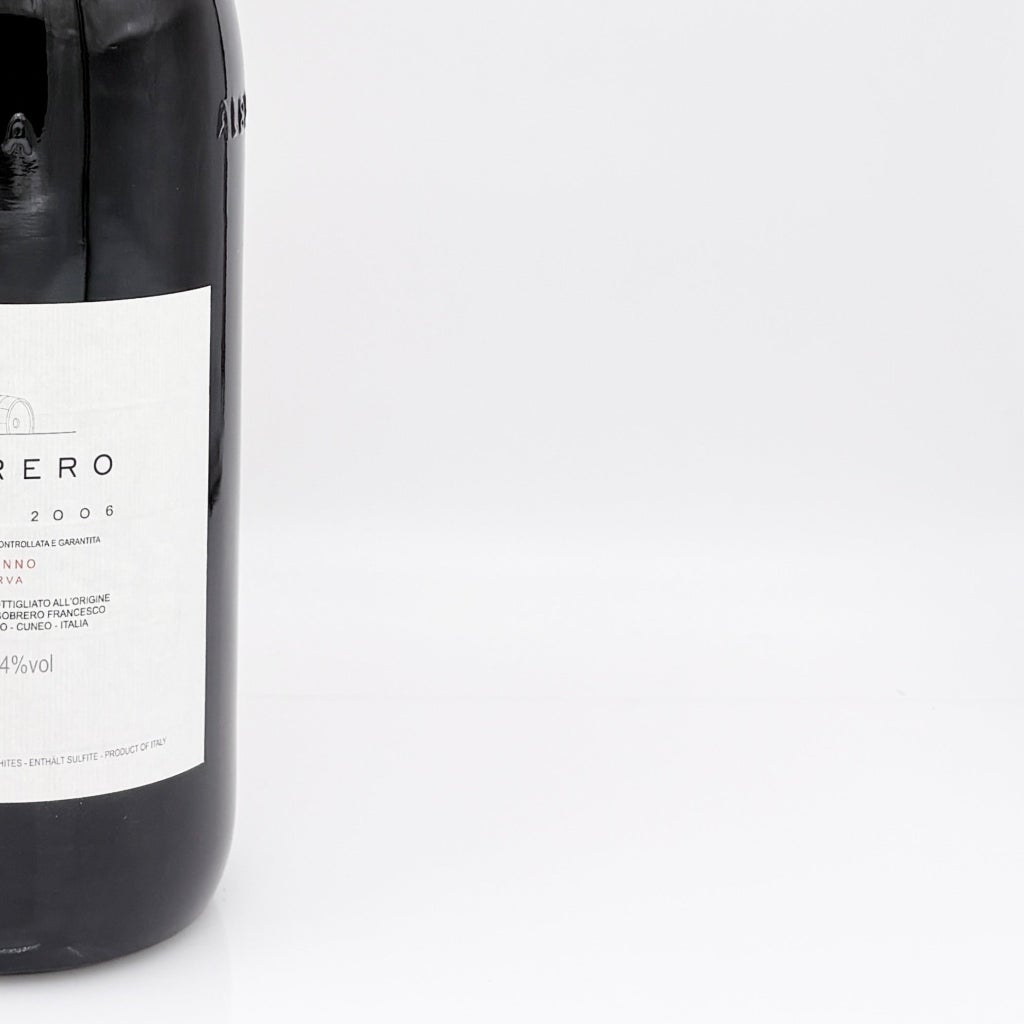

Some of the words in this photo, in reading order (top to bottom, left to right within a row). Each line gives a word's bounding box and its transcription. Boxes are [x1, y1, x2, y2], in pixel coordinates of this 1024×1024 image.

[30, 505, 114, 522] 2006
[51, 538, 57, 547] E
[58, 535, 101, 547] GARANTITA
[52, 593, 111, 607] ALL'ORIGINE
[47, 605, 106, 618] FRANCESCO
[16, 621, 52, 632] CUNEO
[60, 619, 89, 630] ITALIA
[67, 752, 98, 764] SULFITE
[104, 744, 141, 758] PRODUCT
[140, 741, 150, 752] OF
[150, 736, 168, 749] ITALY
